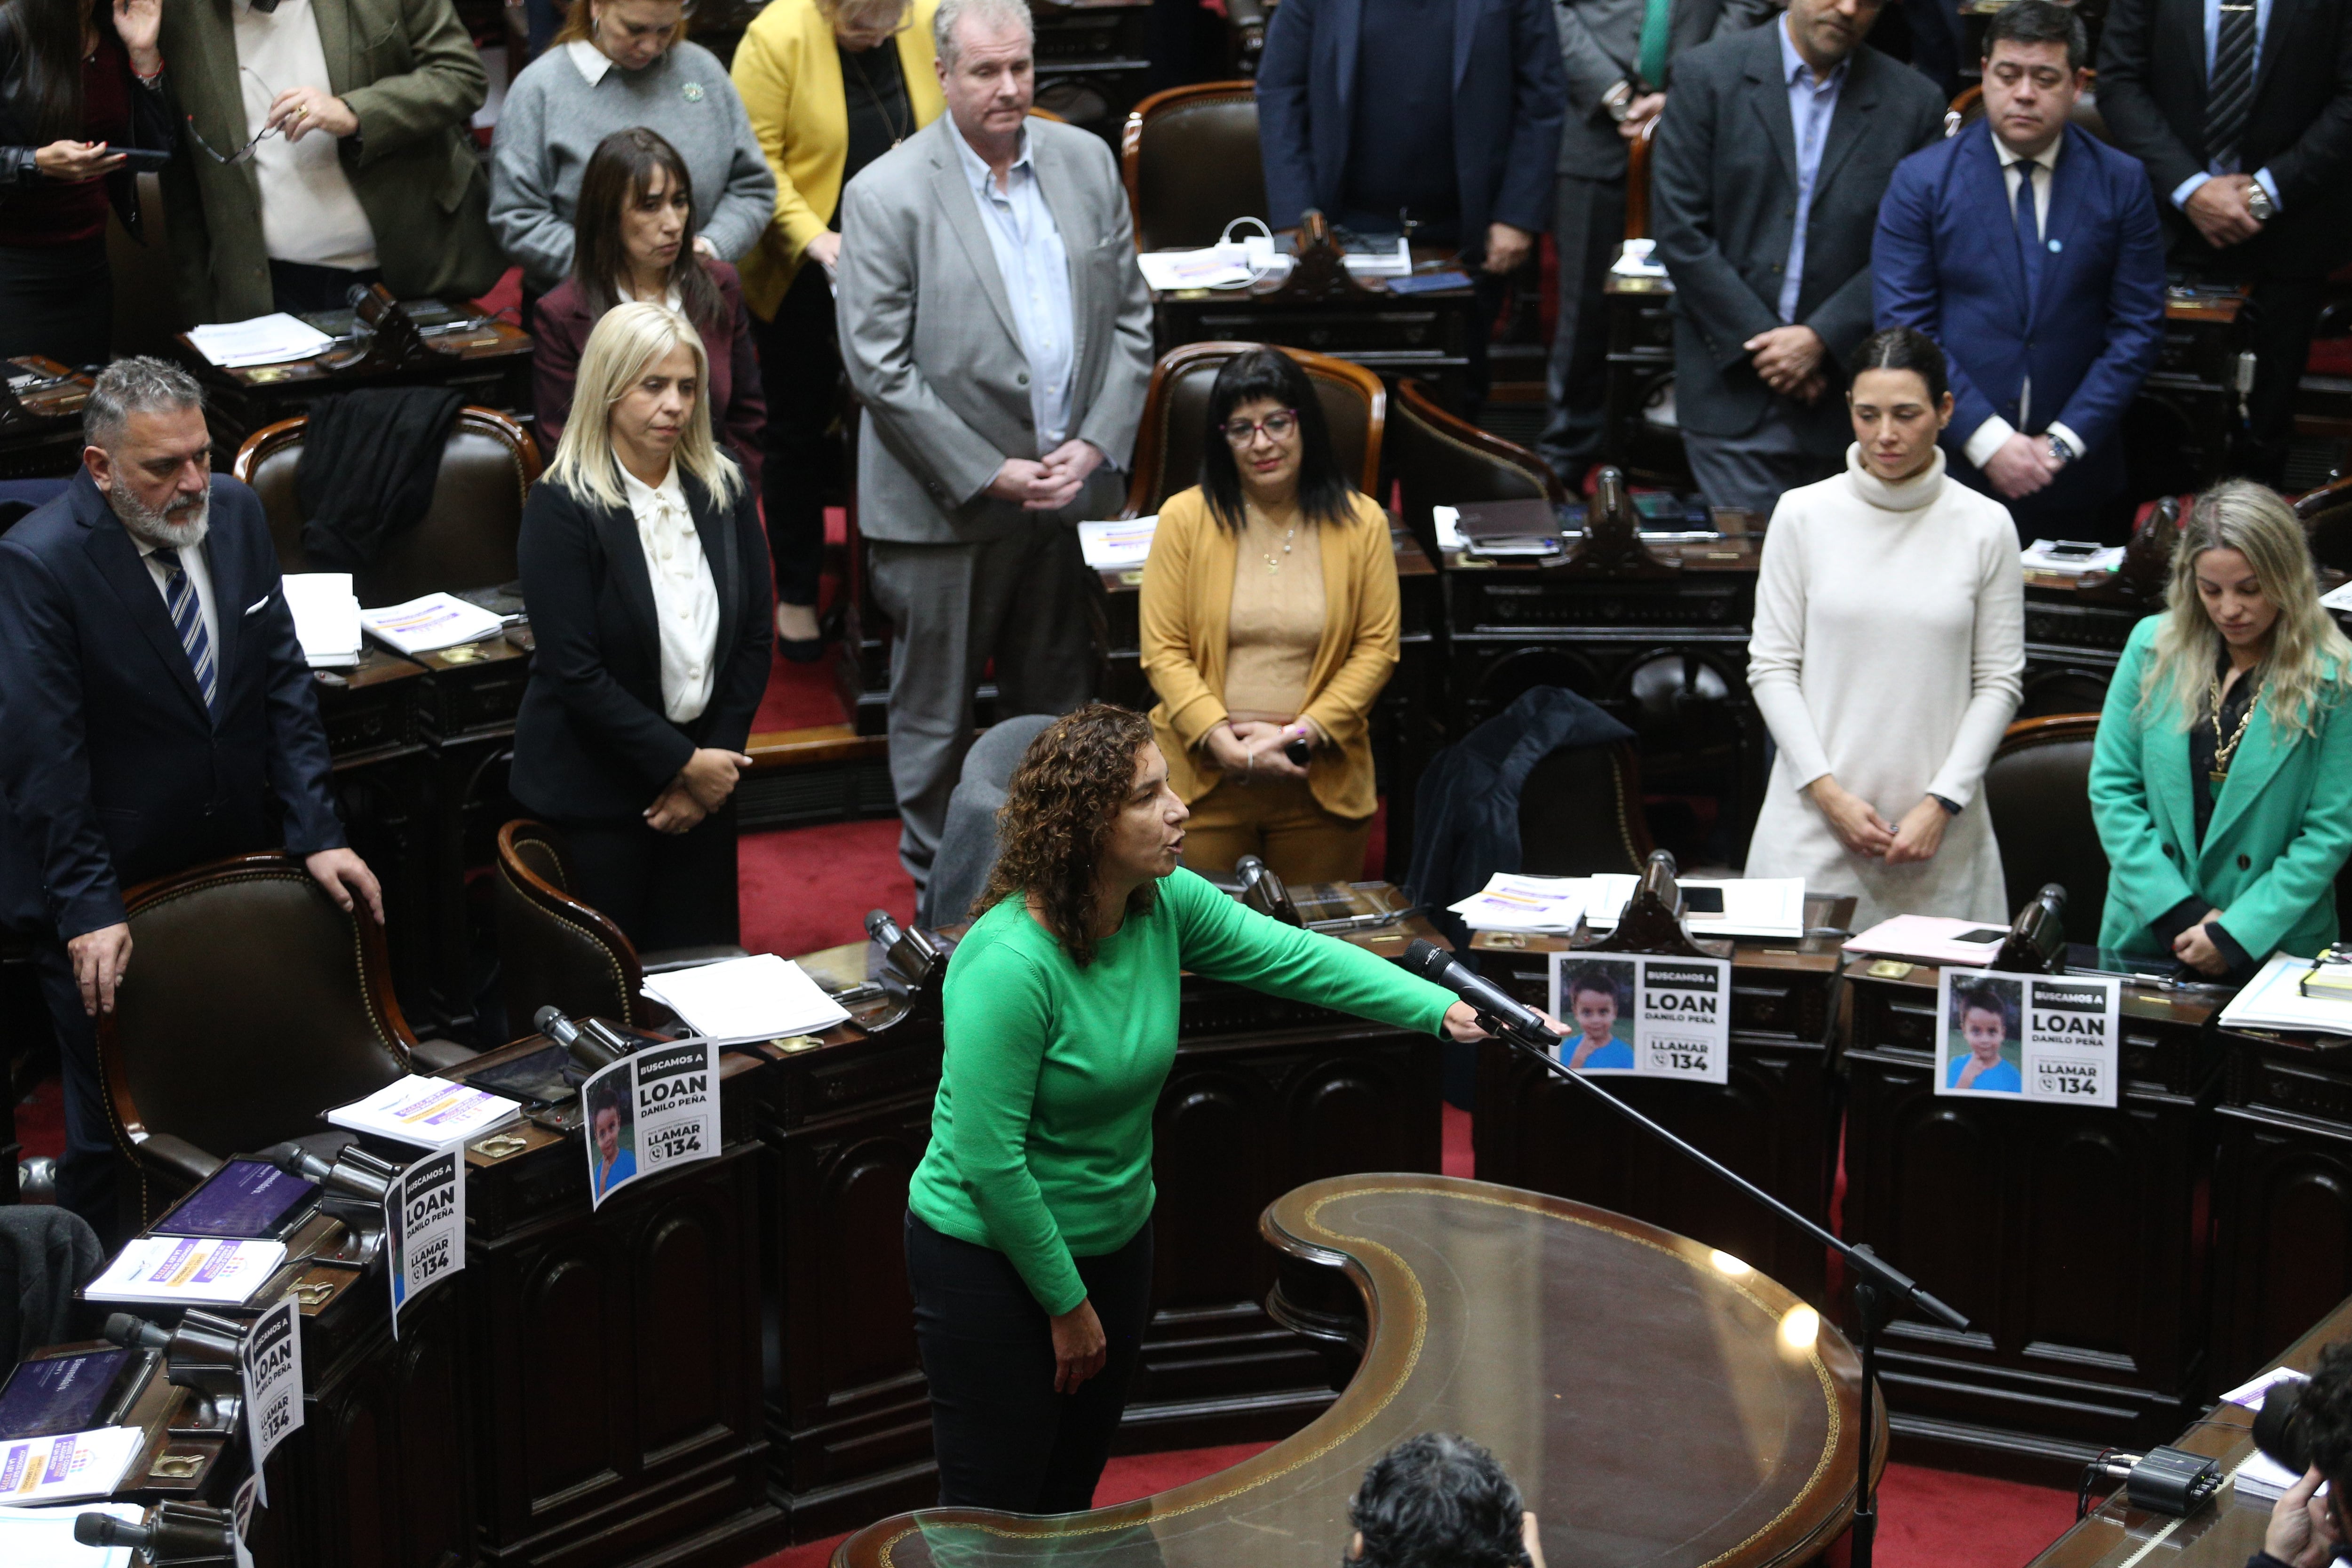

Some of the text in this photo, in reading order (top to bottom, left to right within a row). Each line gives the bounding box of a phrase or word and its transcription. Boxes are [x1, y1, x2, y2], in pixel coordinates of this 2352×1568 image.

[1647, 971, 1716, 984] BUSCAMOS A
[1645, 993, 1716, 1013] LOAN
[2034, 991, 2104, 1005] BUSCAMOS A
[1645, 1012, 1716, 1024] DANILO PEÑA
[2033, 1014, 2104, 1035] LOAN
[1652, 1040, 1708, 1053] LLAMAR
[2032, 1035, 2104, 1046] DANILO PEÑA
[640, 1055, 693, 1075] BUSCAMOS
[1671, 1053, 1708, 1071] 134
[2039, 1064, 2097, 1076] LLAMAR
[640, 1075, 707, 1107] LOAN
[2058, 1077, 2097, 1094] 134
[641, 1095, 707, 1118] DANILO PEÑA
[648, 1124, 700, 1146] LLAMAR
[665, 1135, 701, 1157] 134
[407, 1164, 452, 1194] BUSCAMOS A
[407, 1186, 454, 1228] LOAN
[407, 1207, 454, 1239] DANILO PEÑA
[202, 1256, 218, 1270] DELITO?
[412, 1239, 448, 1268] LLAMAR
[422, 1250, 449, 1278] 134
[254, 1318, 288, 1353] BUSCAMOS A
[255, 1339, 292, 1389] LOAN
[257, 1362, 292, 1401] DANILO PEÑA
[262, 1395, 288, 1430] LLAMAR
[269, 1409, 289, 1439] 134
[6, 1464, 16, 1473] LEY
[48, 1455, 59, 1470] DELITO?
